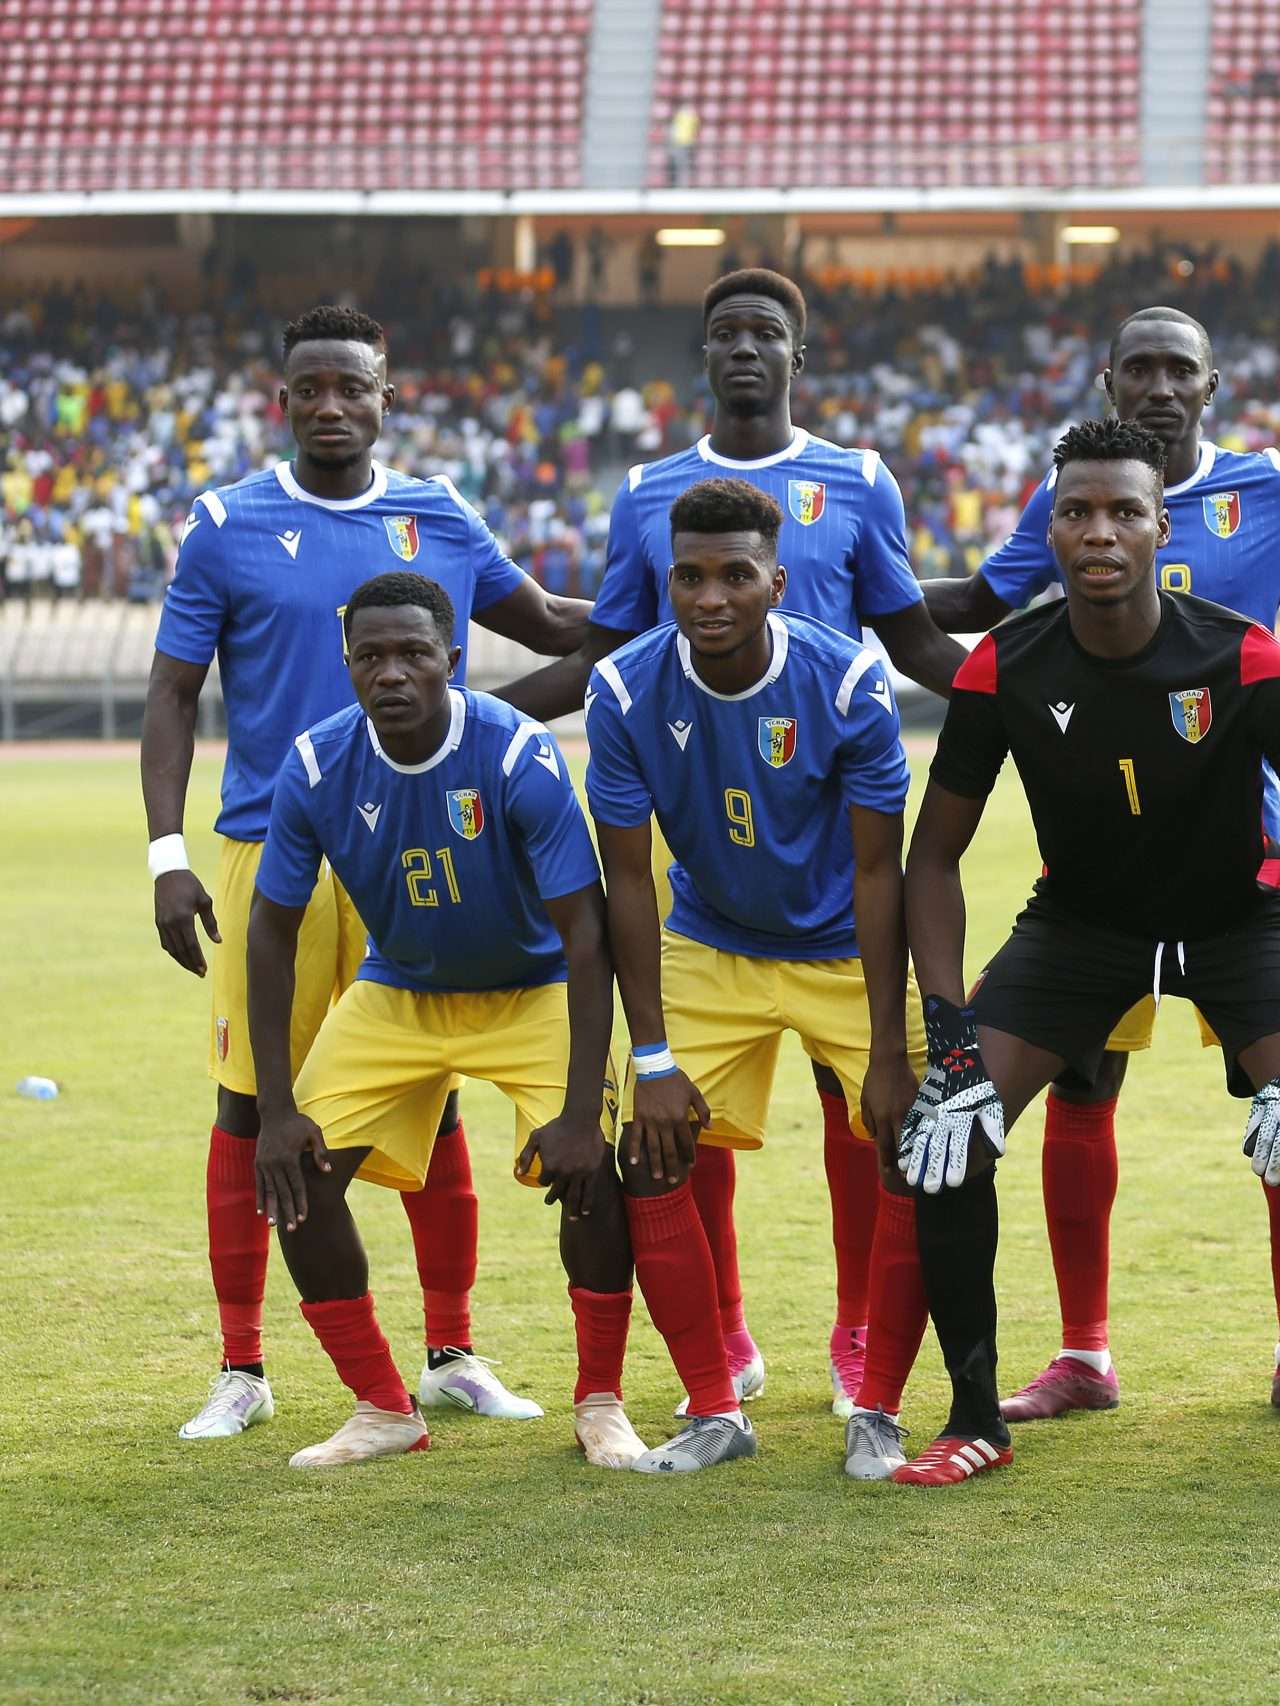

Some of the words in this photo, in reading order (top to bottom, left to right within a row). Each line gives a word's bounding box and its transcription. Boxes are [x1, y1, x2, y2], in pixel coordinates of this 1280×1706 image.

[1176, 690, 1203, 700] TCHAD
[767, 719, 791, 728] TCHAD
[1119, 759, 1141, 815] 1
[725, 788, 755, 847] 9
[402, 847, 462, 906] 21
